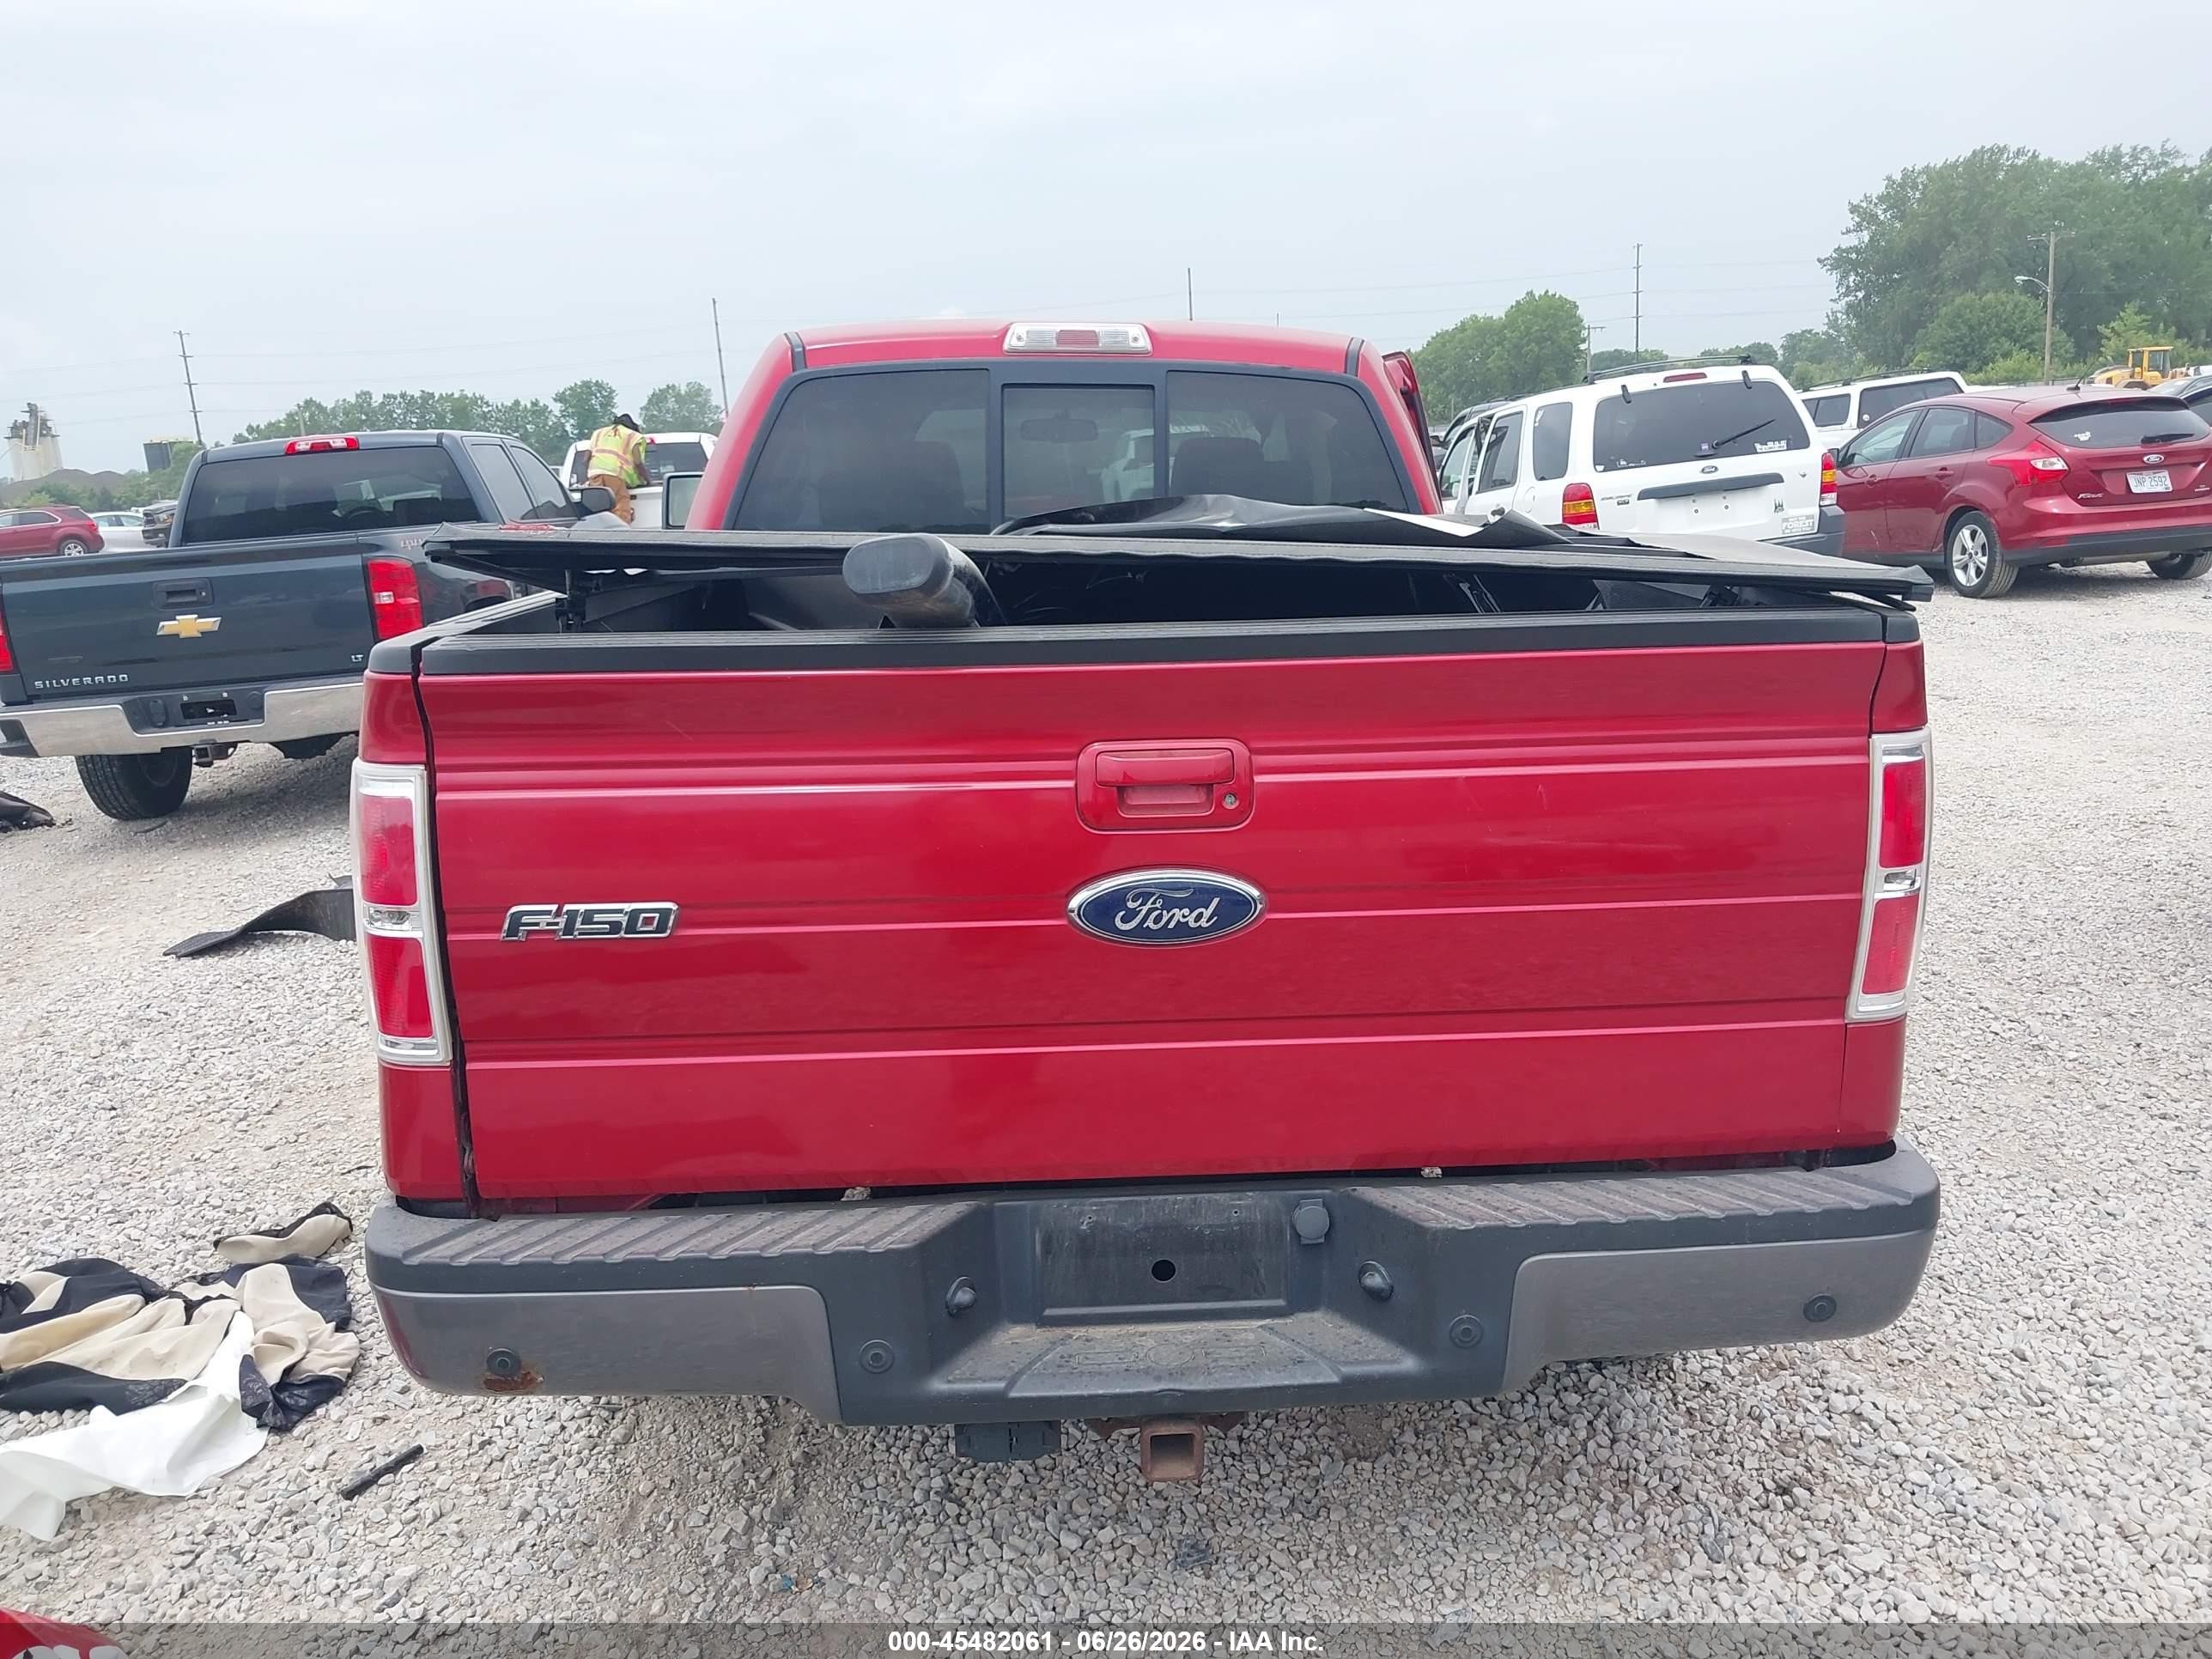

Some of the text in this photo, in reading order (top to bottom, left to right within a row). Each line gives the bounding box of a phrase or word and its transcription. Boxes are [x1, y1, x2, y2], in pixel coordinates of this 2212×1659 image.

[2148, 476, 2169, 487] 2592
[1782, 519, 1814, 530] FOREST
[34, 674, 130, 689] SILVERADO
[1115, 888, 1220, 931] Ford
[501, 901, 681, 942] F-150
